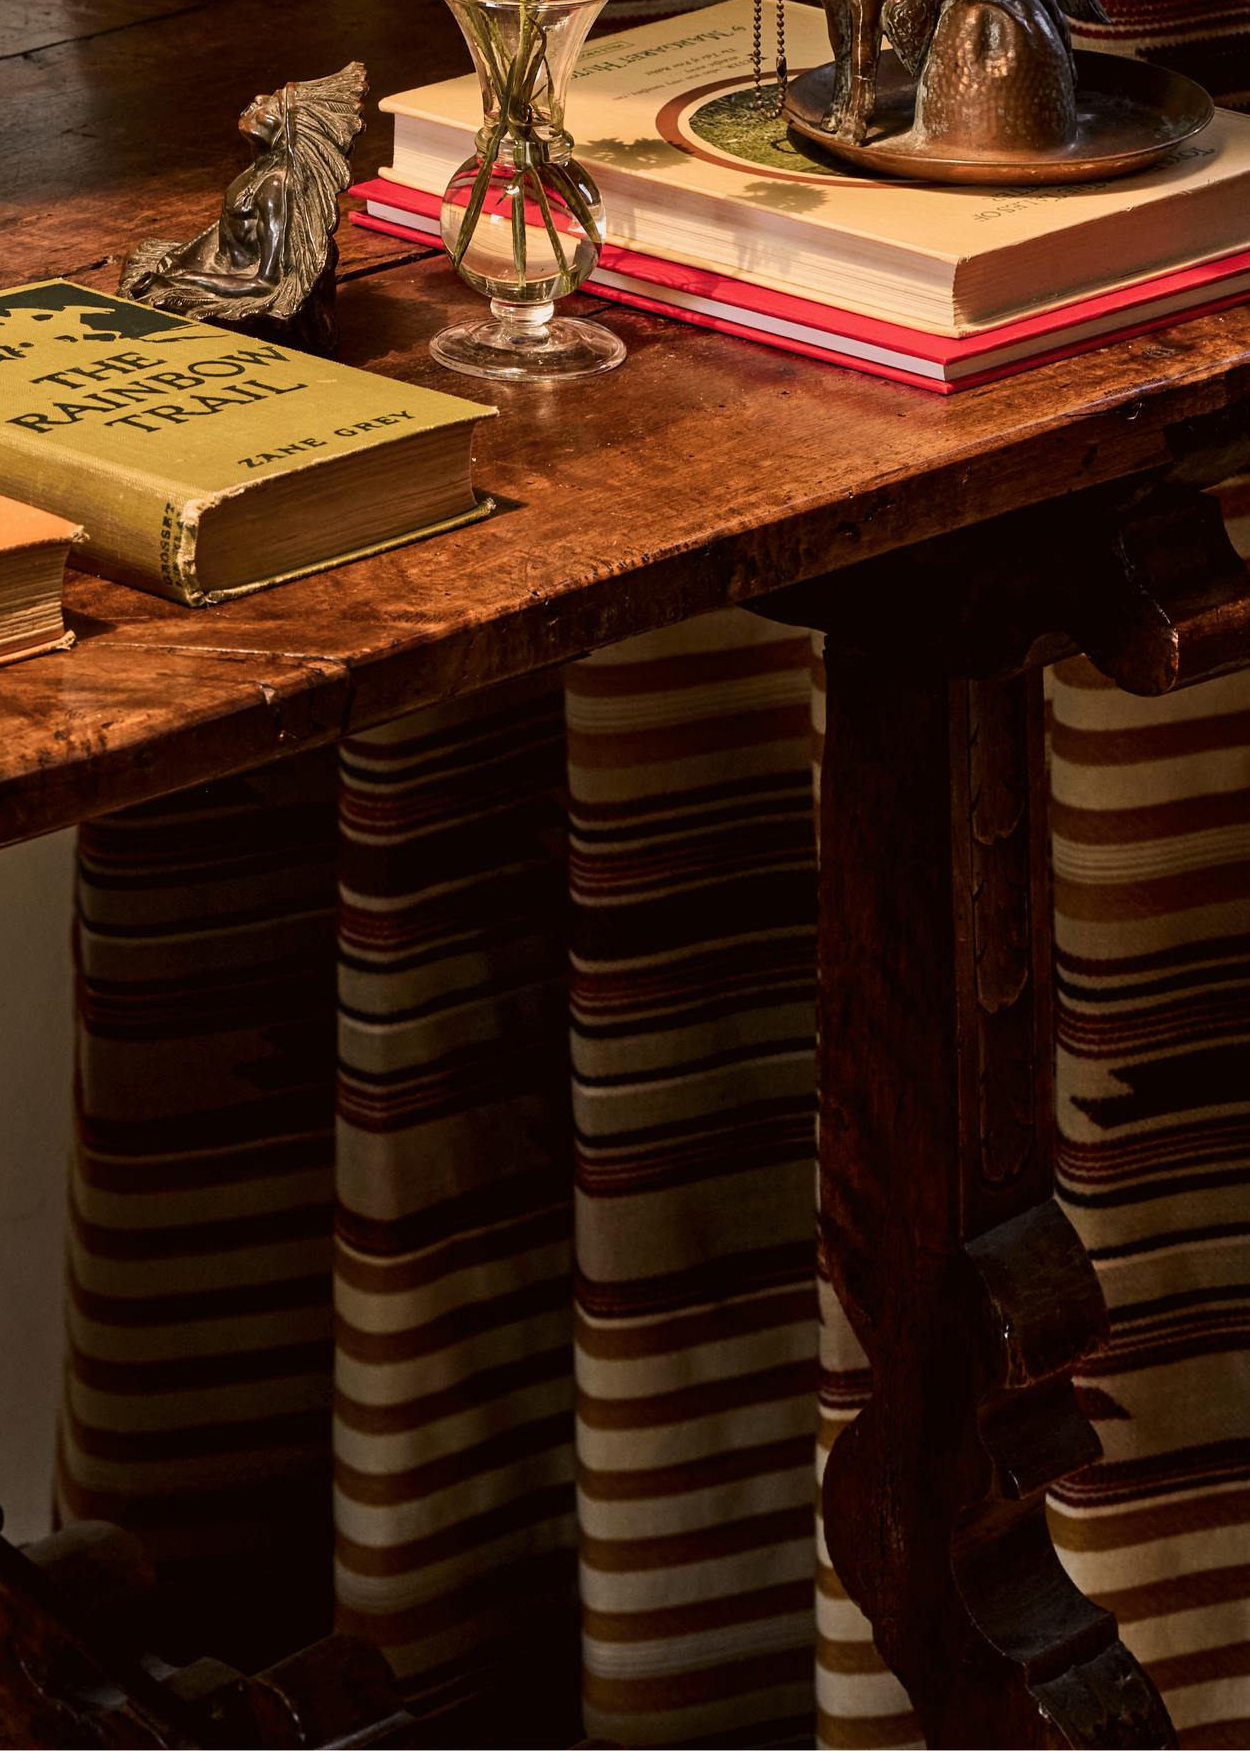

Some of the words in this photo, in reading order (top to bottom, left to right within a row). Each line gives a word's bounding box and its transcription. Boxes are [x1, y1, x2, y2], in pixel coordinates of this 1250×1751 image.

[5, 346, 290, 433] RAINBOW
[29, 352, 167, 389] THE
[104, 380, 309, 432] TRAIL
[237, 437, 328, 469] ZANE
[333, 410, 416, 437] GREY
